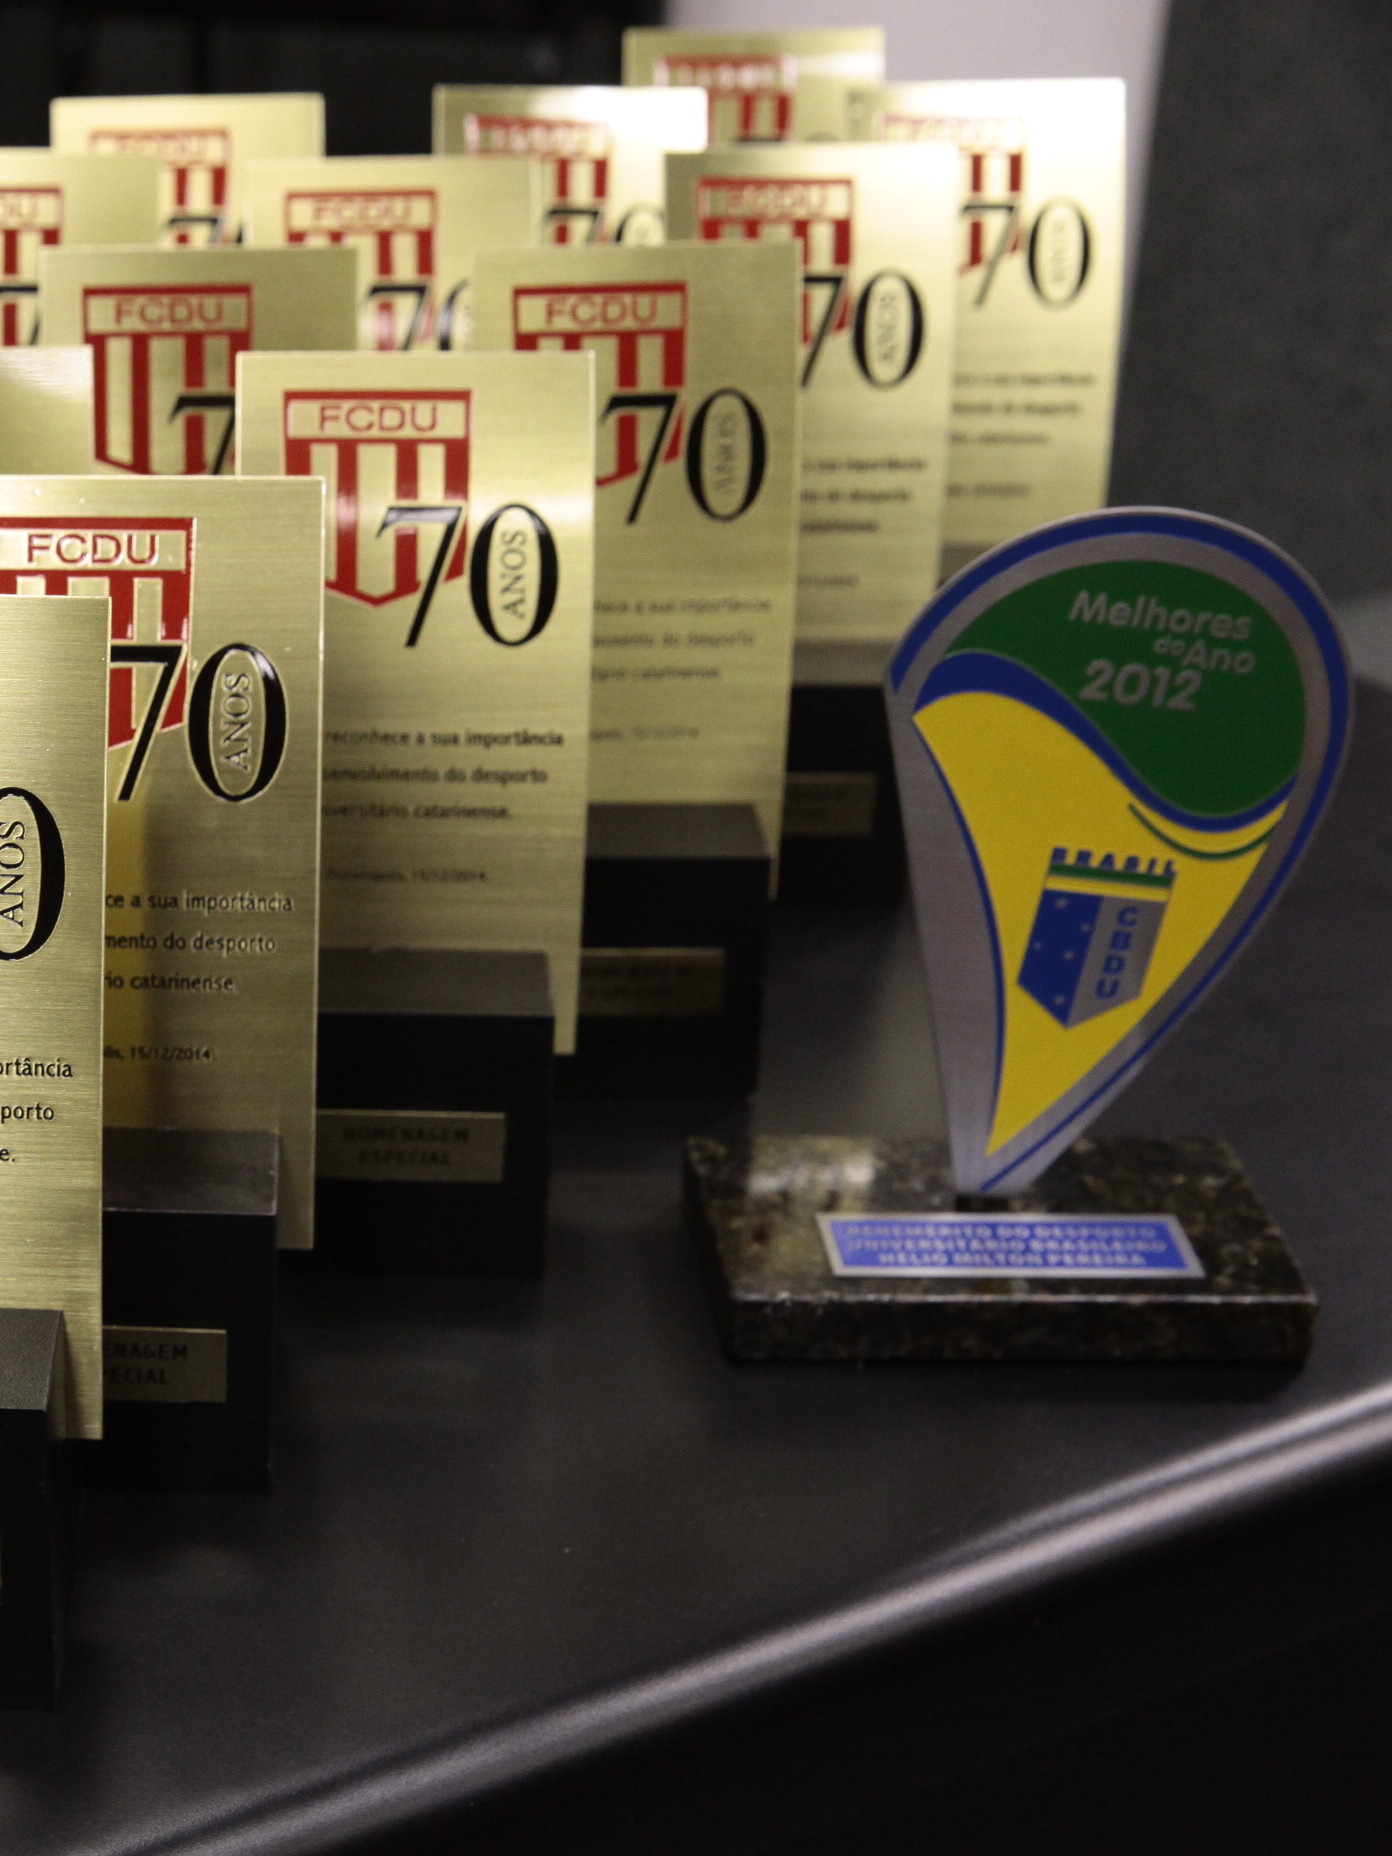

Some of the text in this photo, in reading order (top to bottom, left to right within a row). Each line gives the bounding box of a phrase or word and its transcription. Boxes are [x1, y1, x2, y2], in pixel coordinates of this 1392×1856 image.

[113, 298, 225, 326] FCDU
[546, 293, 658, 326] FCDU
[320, 404, 438, 432] FCDU
[598, 387, 766, 525] 70
[27, 533, 158, 566] FCDU
[376, 504, 559, 647] 70
[500, 529, 528, 620] ANOS
[1069, 591, 1254, 641] Melhores
[1182, 639, 1256, 675] Ano
[1078, 659, 1203, 711] 2012
[110, 643, 287, 803] 70
[219, 672, 253, 773] ANOS
[130, 893, 142, 909] a
[148, 893, 179, 910] sua
[184, 889, 295, 916] importância
[163, 931, 187, 950] do
[192, 931, 276, 958] desporto
